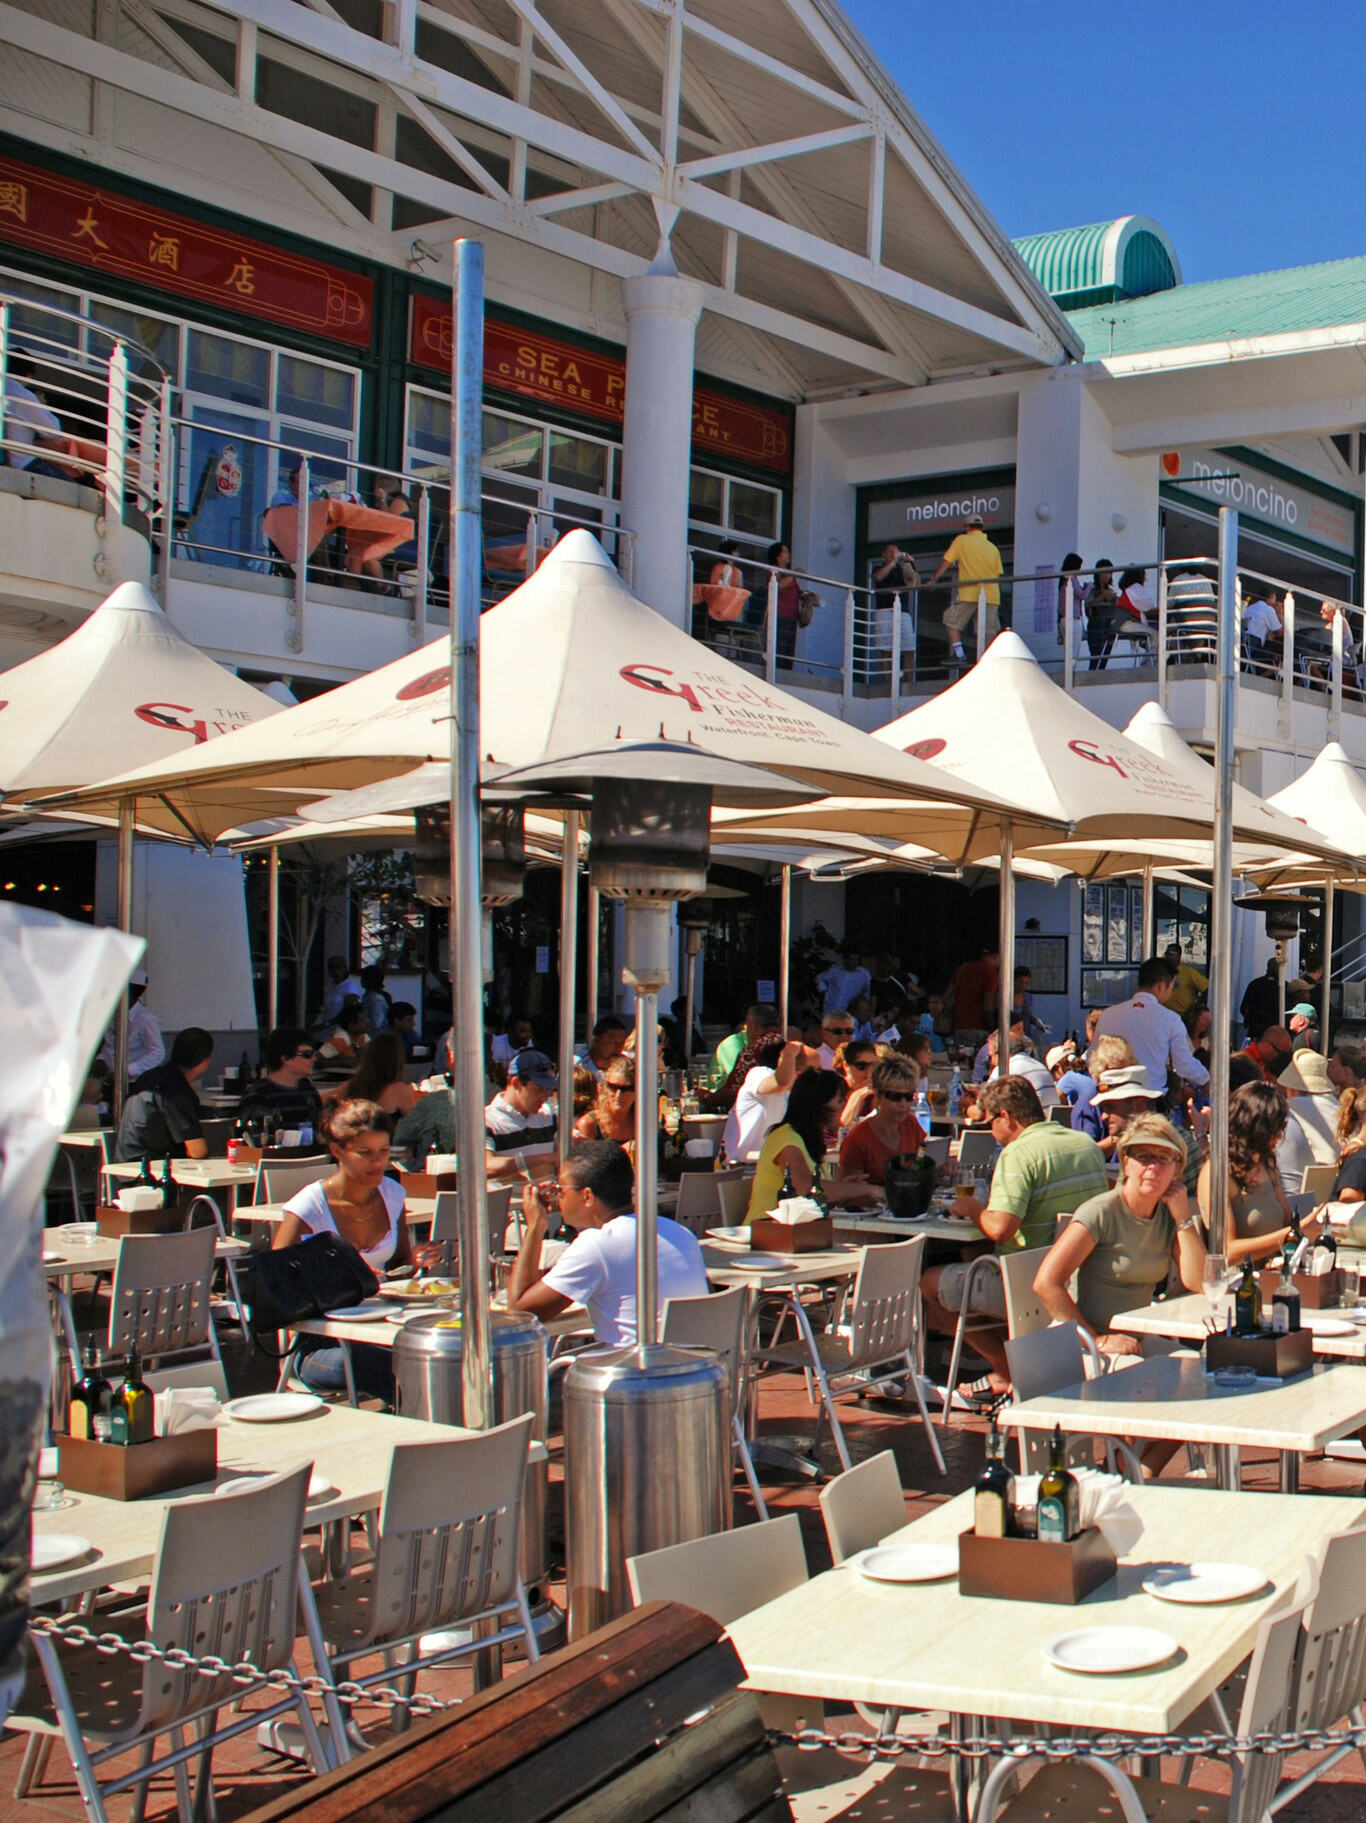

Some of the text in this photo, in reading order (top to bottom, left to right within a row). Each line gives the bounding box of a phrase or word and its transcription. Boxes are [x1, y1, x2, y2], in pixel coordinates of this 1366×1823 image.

[516, 346, 582, 384] SEA
[500, 362, 591, 399] CHINESE
[1192, 459, 1298, 524] meloncino
[906, 495, 1000, 521] meloncino
[692, 671, 732, 686] THE
[214, 708, 253, 720] THE
[711, 703, 816, 728] Fisherman
[725, 717, 828, 738] RESTAURANT
